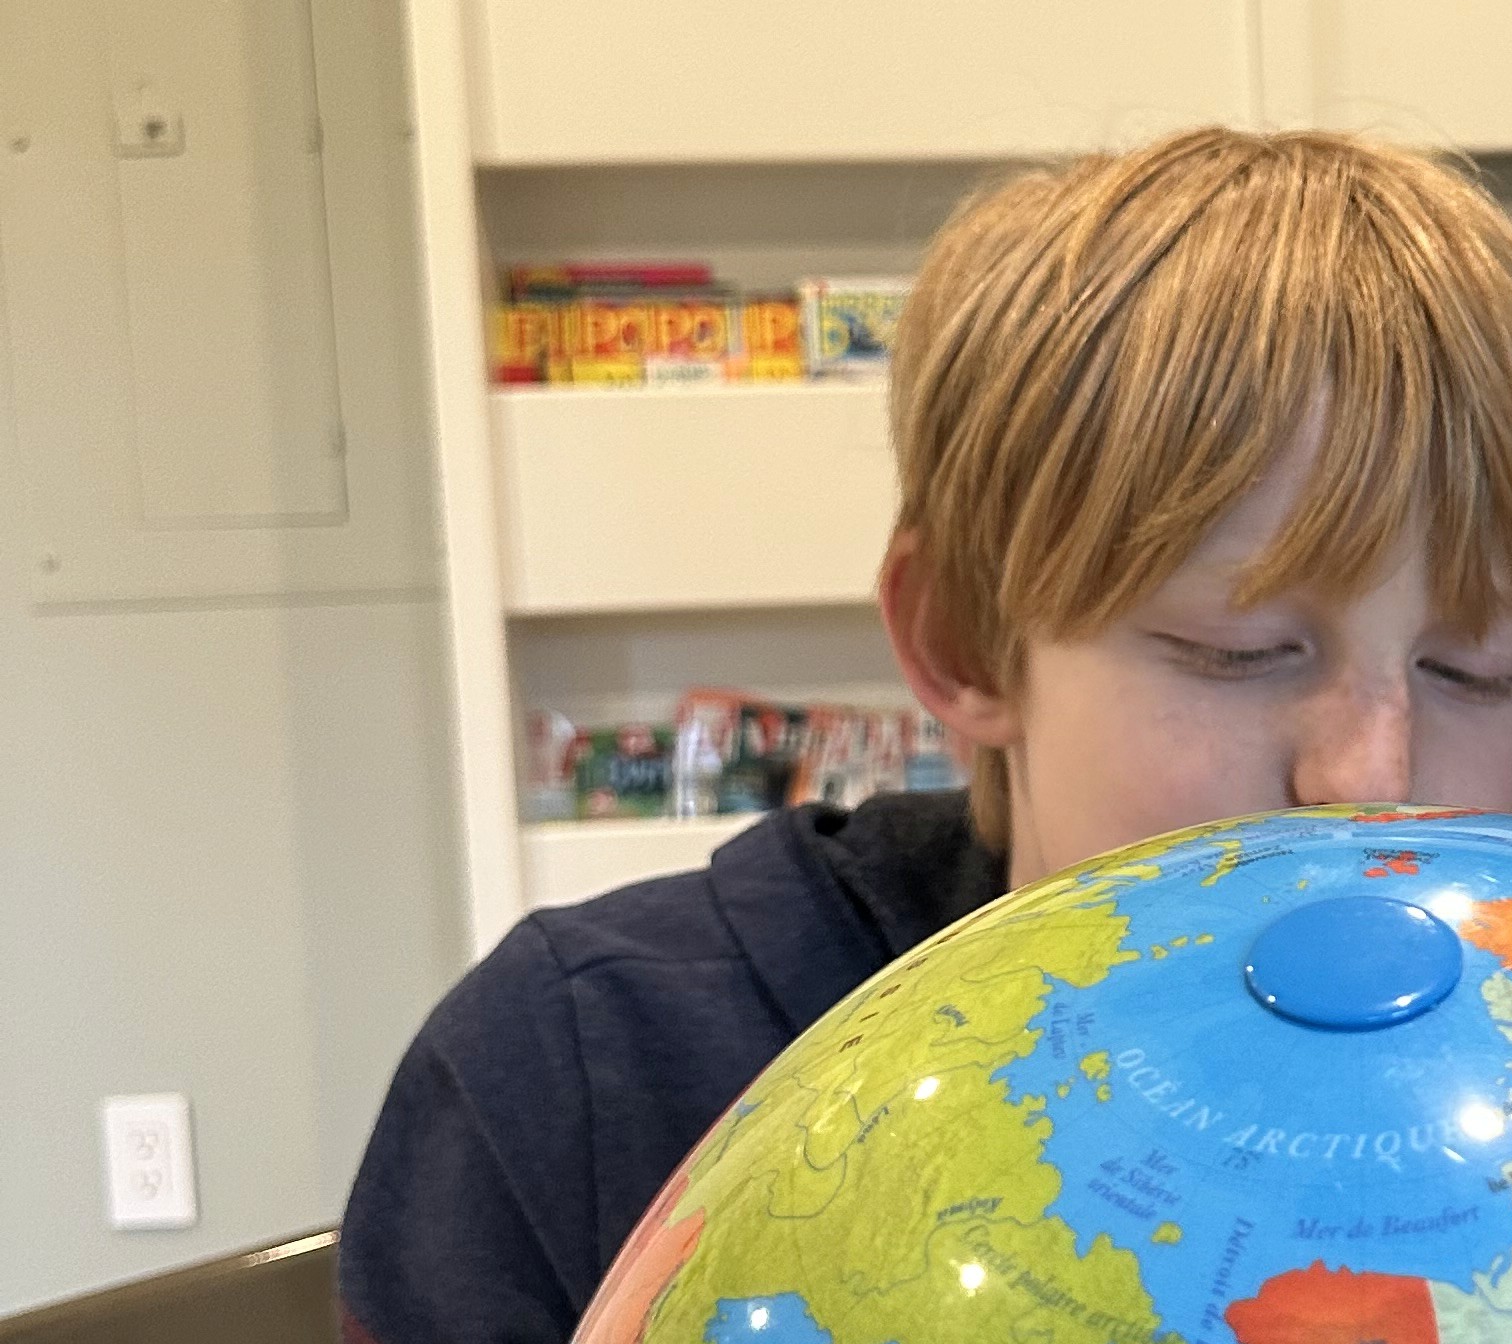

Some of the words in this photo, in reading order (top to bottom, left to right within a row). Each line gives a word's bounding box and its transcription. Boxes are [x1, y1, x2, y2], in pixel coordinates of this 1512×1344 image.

[1116, 1047, 1225, 1132] OCÉAN
[1294, 1215, 1344, 1241] Mer
[1380, 1206, 1480, 1238] Beaufort
